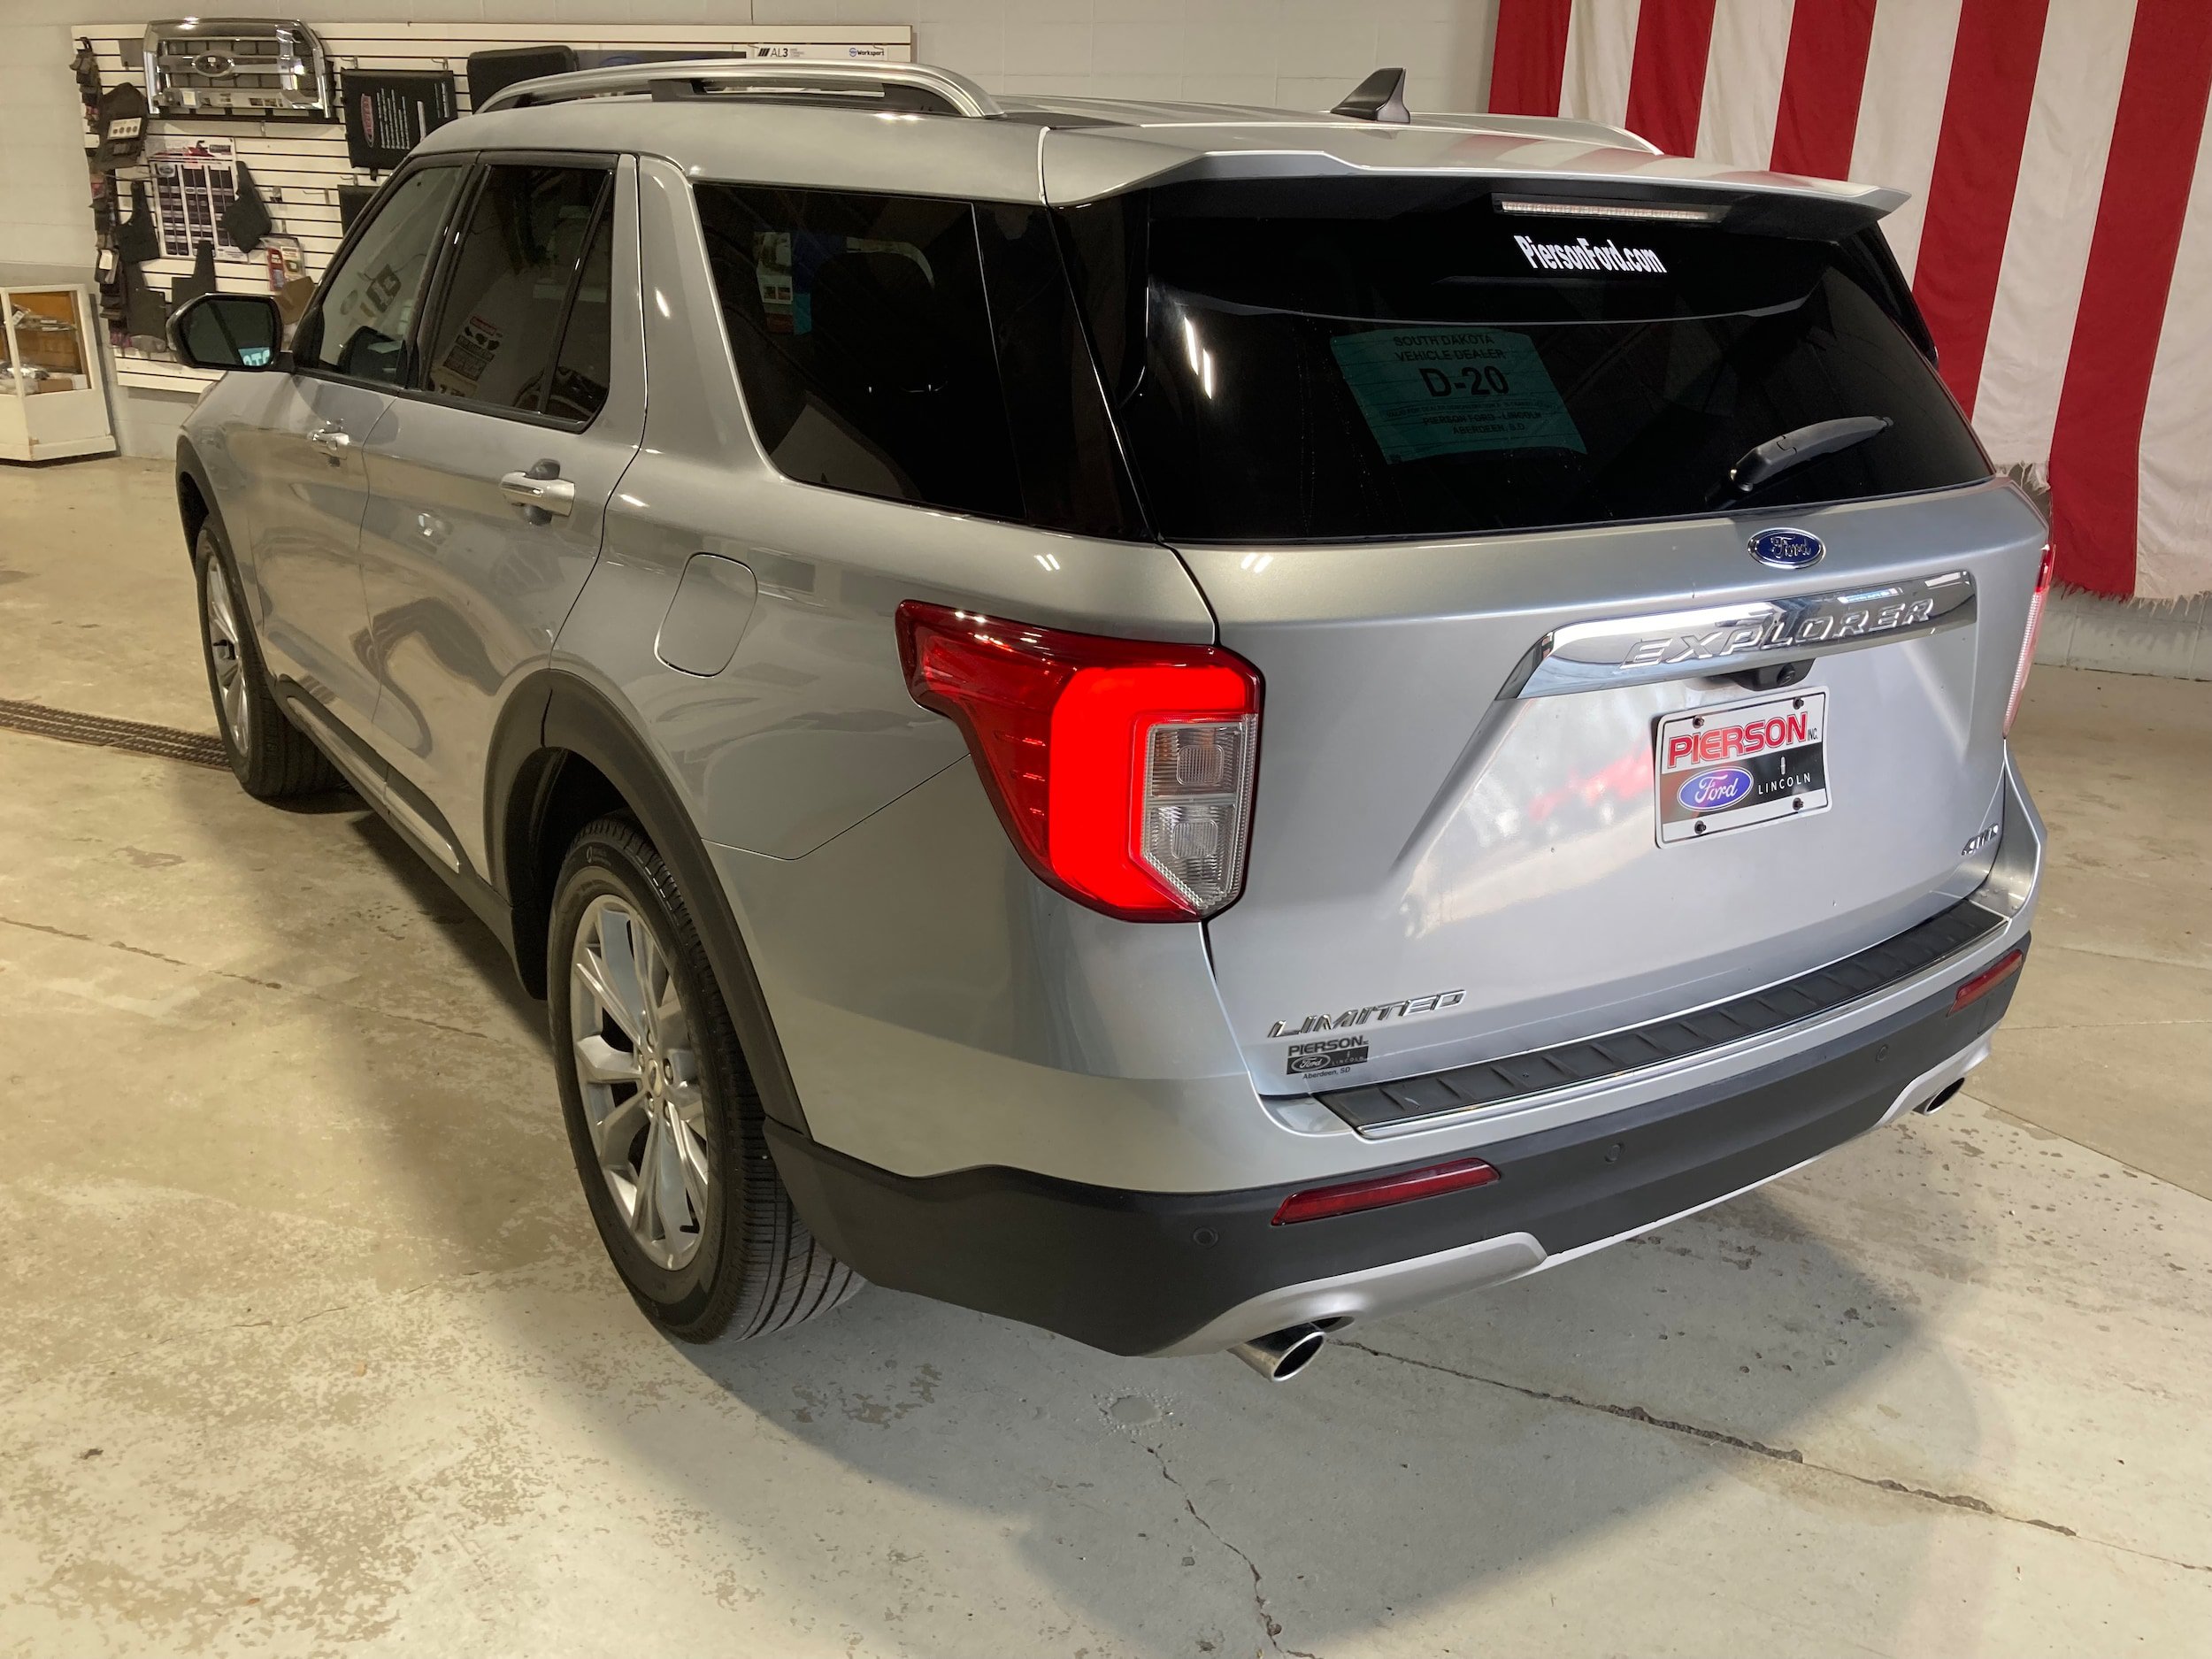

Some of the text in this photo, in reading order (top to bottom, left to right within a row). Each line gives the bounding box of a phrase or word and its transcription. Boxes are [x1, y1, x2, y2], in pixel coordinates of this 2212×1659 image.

[1514, 235, 1668, 273] PiersonFord.com
[1394, 334, 1494, 346] SOUTH DAKOTA
[1394, 349, 1507, 361] VEHICLE DEALER
[1418, 365, 1509, 397] D-20
[1423, 415, 1467, 425] PIERSON
[1770, 535, 1812, 559] Ford
[1620, 597, 1934, 669] EXPLORER
[1667, 711, 1808, 769] PIERSON
[1694, 774, 1739, 803] Ford
[1758, 772, 1811, 795] LINCOLN
[1267, 989, 1467, 1038] LIMITED
[1288, 1035, 1363, 1056] PIERSON
[1300, 1057, 1323, 1069] Ford
[1302, 1070, 1339, 1079] Aberdeen,
